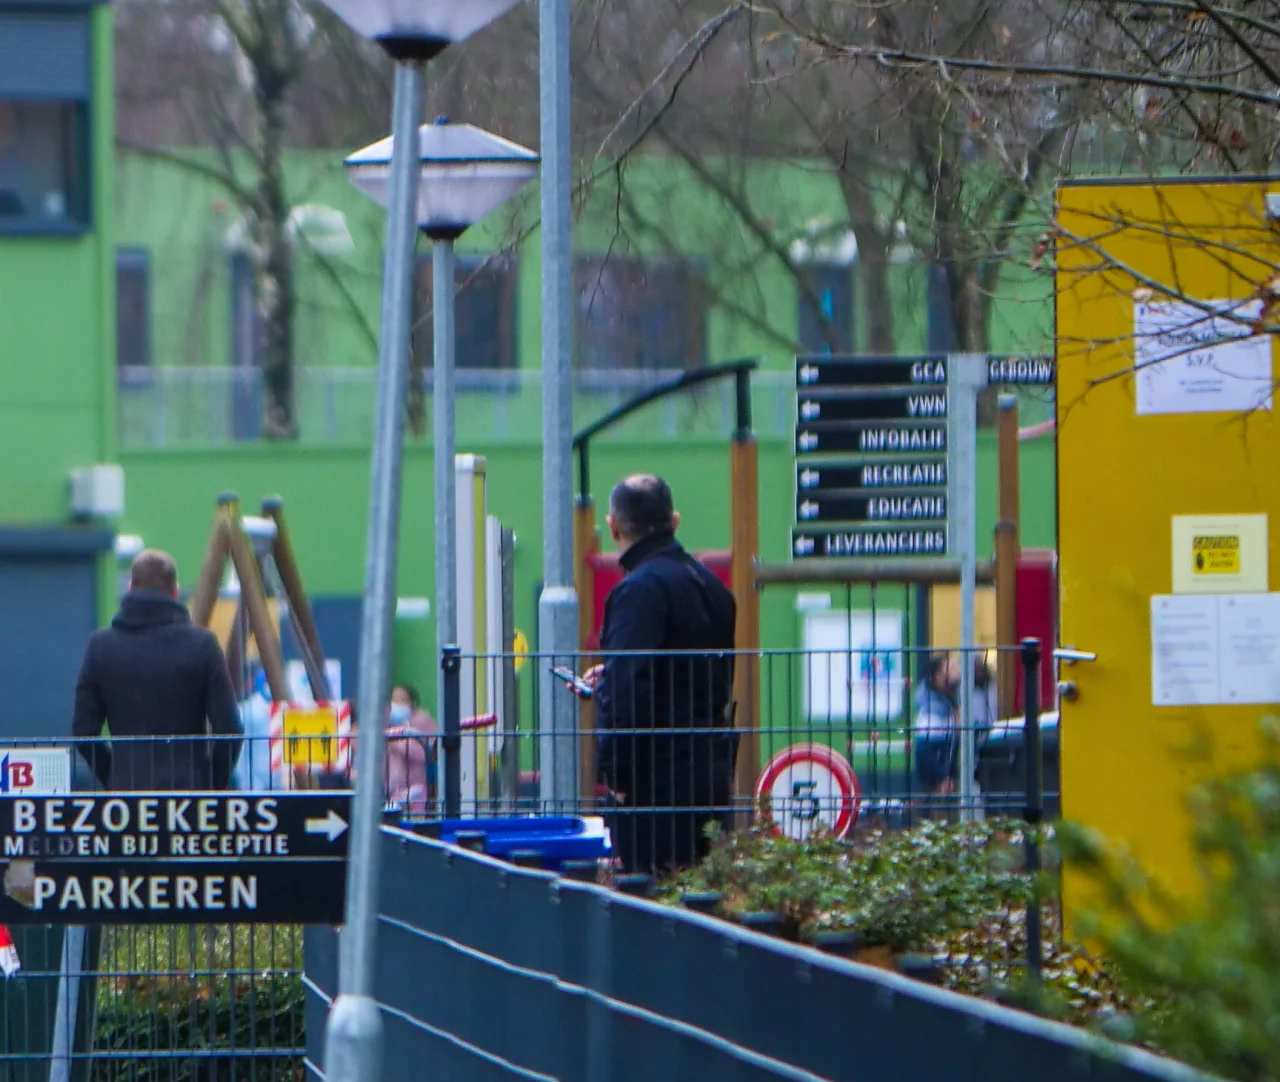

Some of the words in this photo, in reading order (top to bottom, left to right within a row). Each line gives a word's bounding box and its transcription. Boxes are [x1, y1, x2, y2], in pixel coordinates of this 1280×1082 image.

[908, 396, 945, 416] VWN
[860, 429, 945, 449] INFOBALIE
[862, 463, 945, 485] RECREATIE
[867, 497, 945, 518] EDUCATIE
[825, 531, 944, 553] LEVERANCIERS
[791, 779, 821, 821] 5
[13, 799, 279, 833] BEZOEKERS
[121, 834, 159, 856] BIJ
[170, 834, 290, 856] RECEPTIE
[32, 876, 258, 909] PARKEREN
